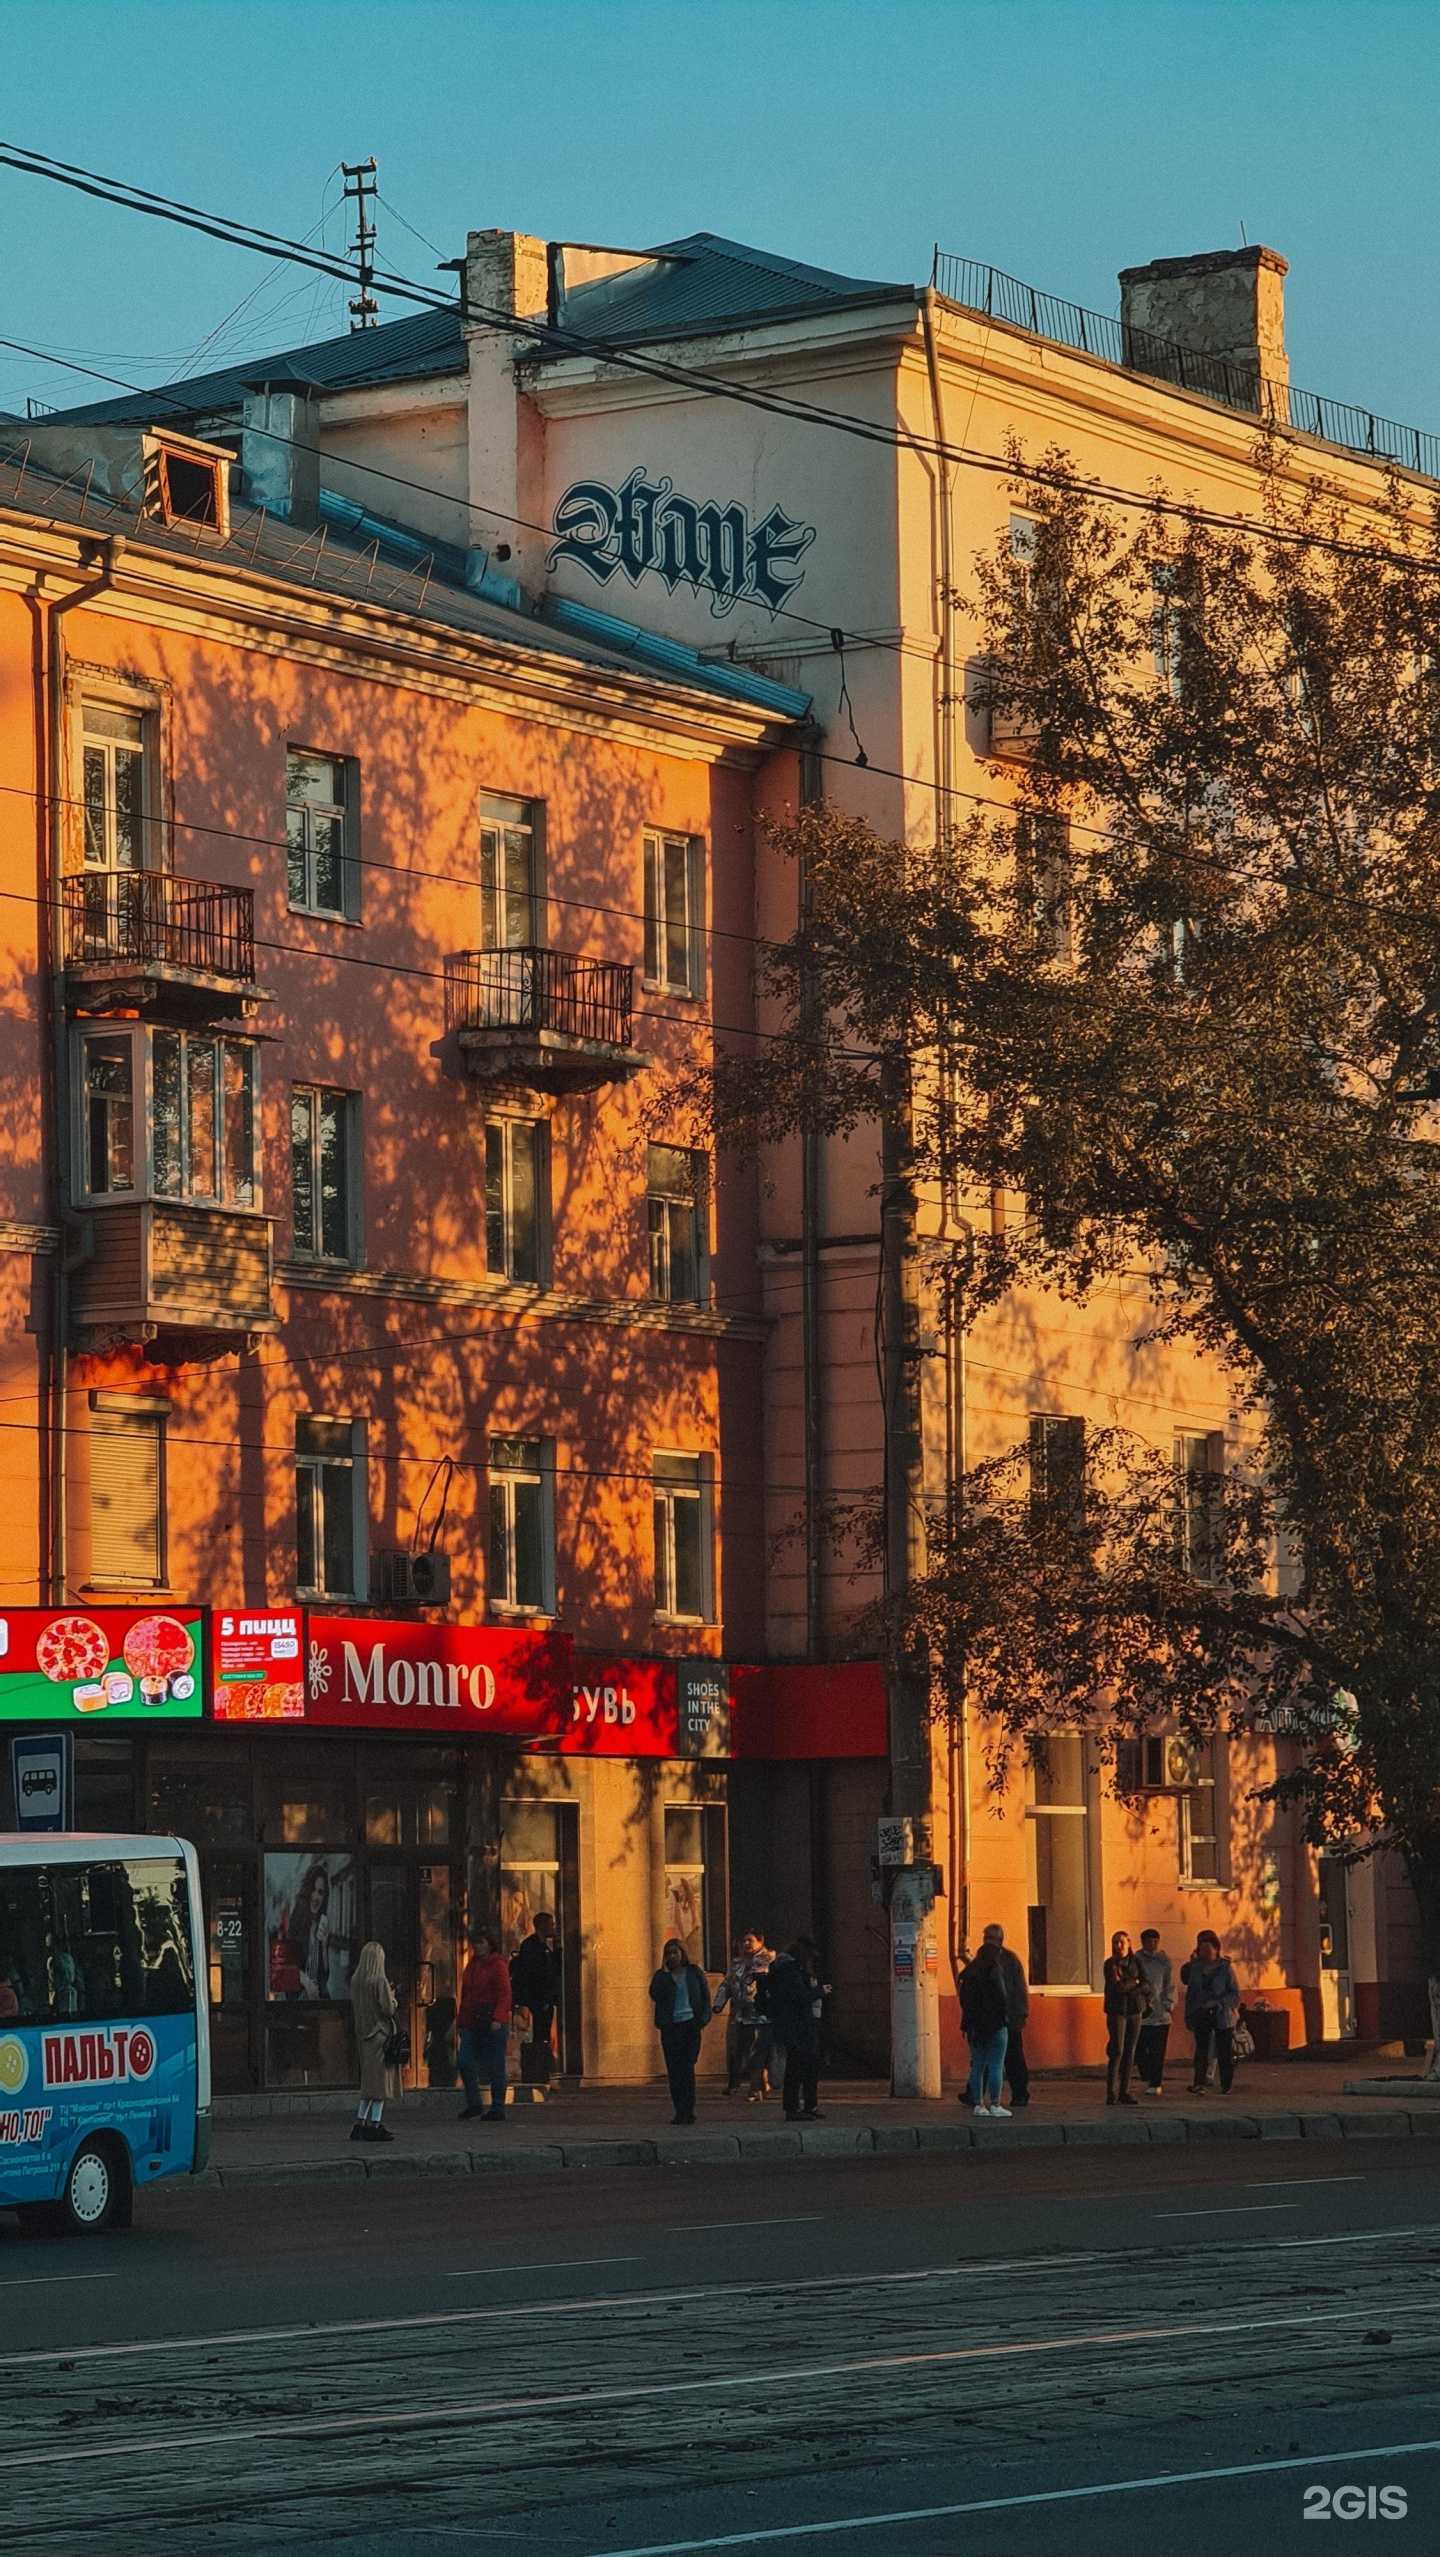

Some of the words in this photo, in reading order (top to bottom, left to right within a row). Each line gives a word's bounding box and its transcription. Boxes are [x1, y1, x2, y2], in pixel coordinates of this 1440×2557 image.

[220, 1617, 234, 1636] 5
[341, 1640, 496, 1710] Monro
[687, 1682, 720, 1697] SHOES
[687, 1700, 699, 1713] IN
[700, 1701, 721, 1715] THE
[687, 1718, 711, 1732] CITY
[216, 1920, 242, 1937] 8-22
[45, 2030, 153, 2084] ПАЛЬТО
